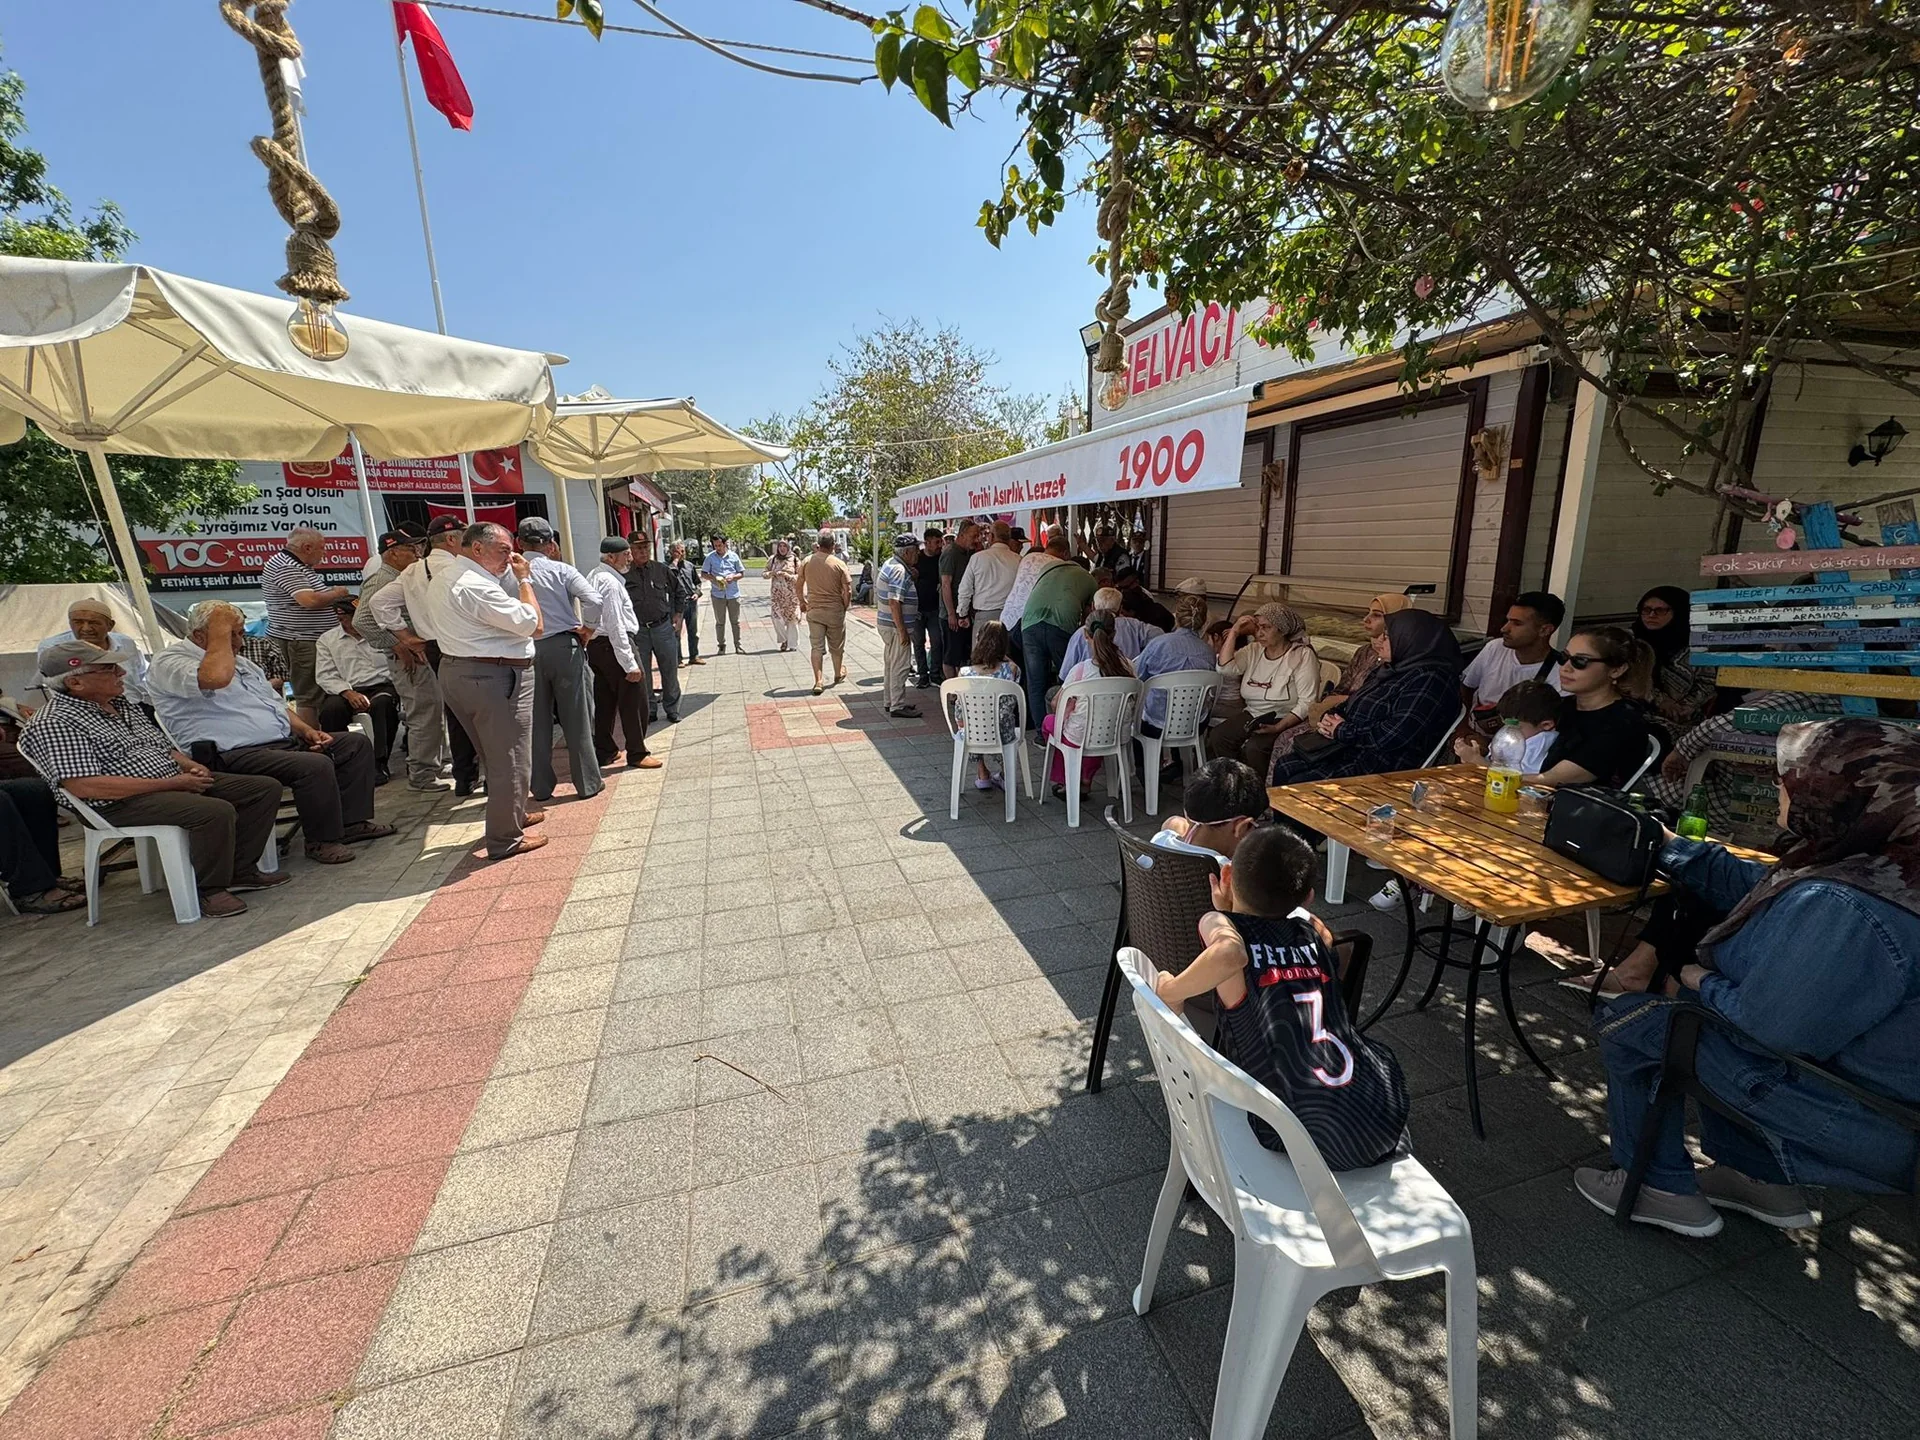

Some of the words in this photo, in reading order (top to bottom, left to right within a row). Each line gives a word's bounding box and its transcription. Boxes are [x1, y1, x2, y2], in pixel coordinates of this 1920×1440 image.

[434, 460, 460, 469] KADAR
[1116, 429, 1205, 491] 1900
[383, 468, 410, 478] DEVAM
[412, 468, 448, 479] EDECEĞİZ
[335, 478, 360, 487] FETHİY
[276, 487, 301, 501] Şad
[306, 487, 344, 498] Olsun
[968, 486, 991, 509] Tarihi
[993, 480, 1024, 506] Asırlık
[1026, 473, 1067, 501] Lezzet
[934, 484, 949, 514] ALİ
[262, 503, 288, 517] Sağ
[292, 503, 331, 514] Olsun
[199, 520, 267, 535] ayrağımız
[271, 520, 296, 531] Var
[299, 520, 337, 531] Olsun
[330, 555, 362, 564] Olsun
[161, 574, 201, 588] FETHİYE
[202, 574, 230, 588] ŞEHİT
[326, 571, 363, 582] DERNEĞ
[1293, 990, 1354, 1088] 3
